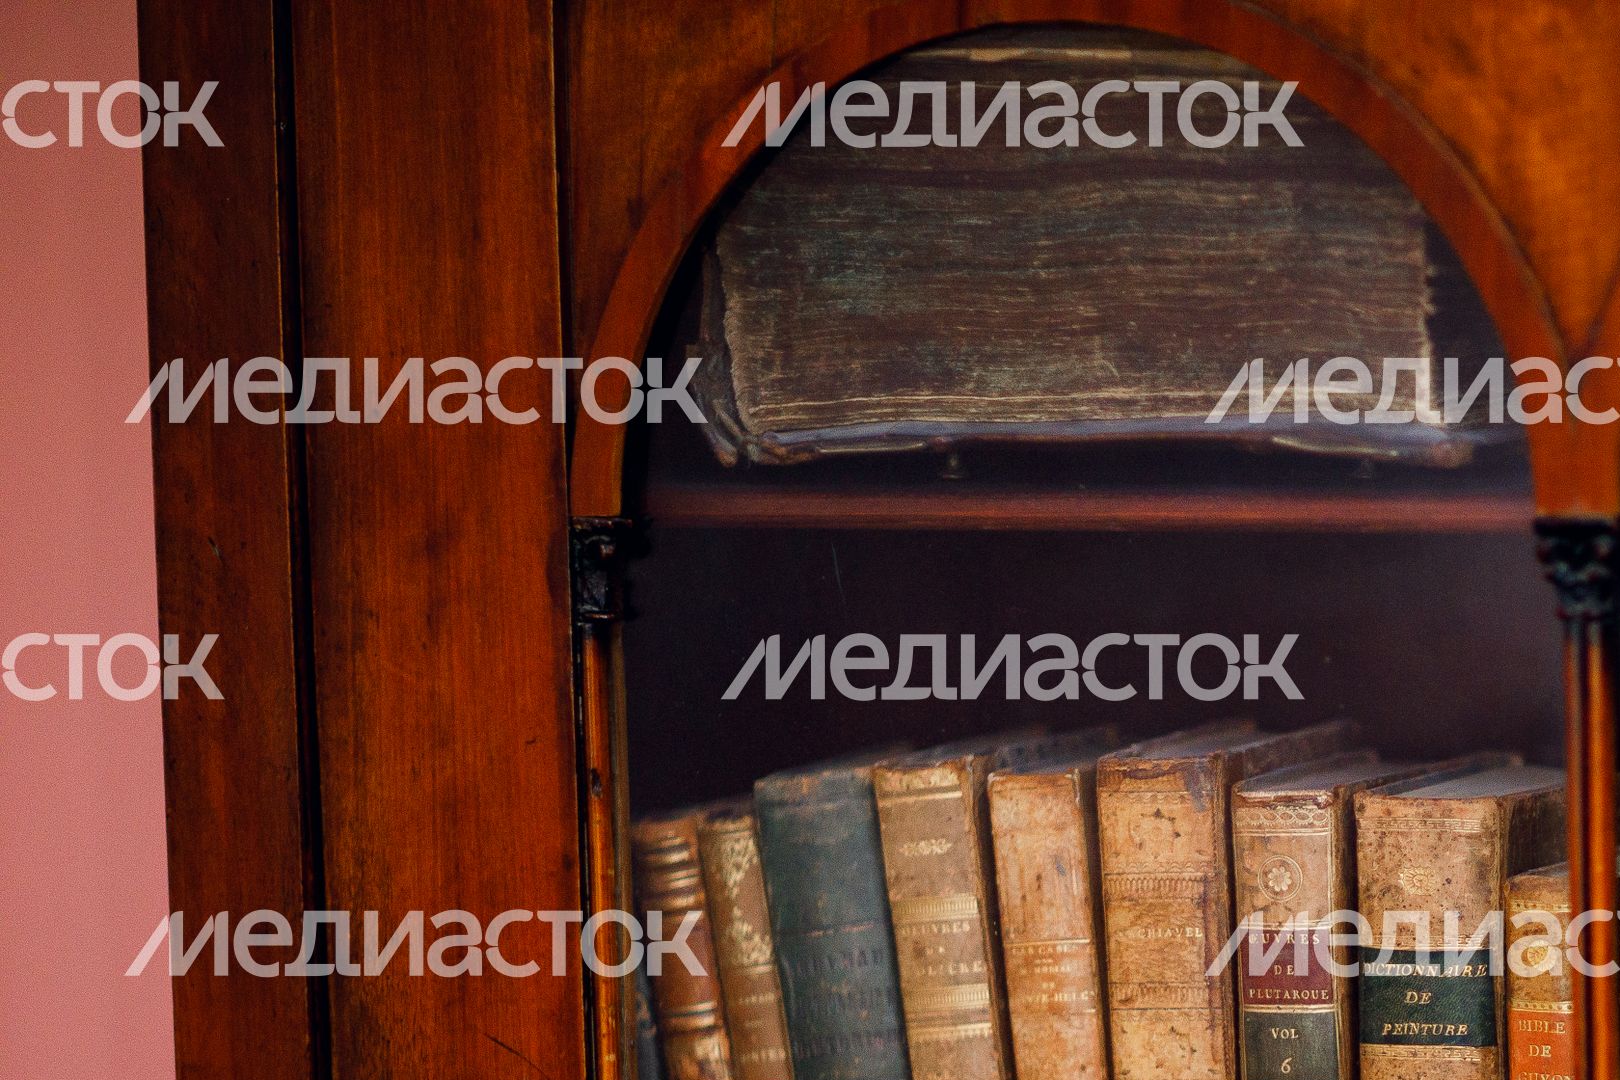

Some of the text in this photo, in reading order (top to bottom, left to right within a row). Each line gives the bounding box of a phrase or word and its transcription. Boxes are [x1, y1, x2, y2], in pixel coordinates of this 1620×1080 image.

[1274, 964, 1294, 976] DE
[1363, 962, 1487, 977] DICTIONNAIRE
[1404, 991, 1432, 1004] DE
[1271, 1028, 1299, 1040] VOL
[1382, 1022, 1469, 1036] PEINTURE
[1518, 1020, 1567, 1035] BIBLE
[1529, 1044, 1552, 1058] DE
[1280, 1056, 1293, 1074] 6
